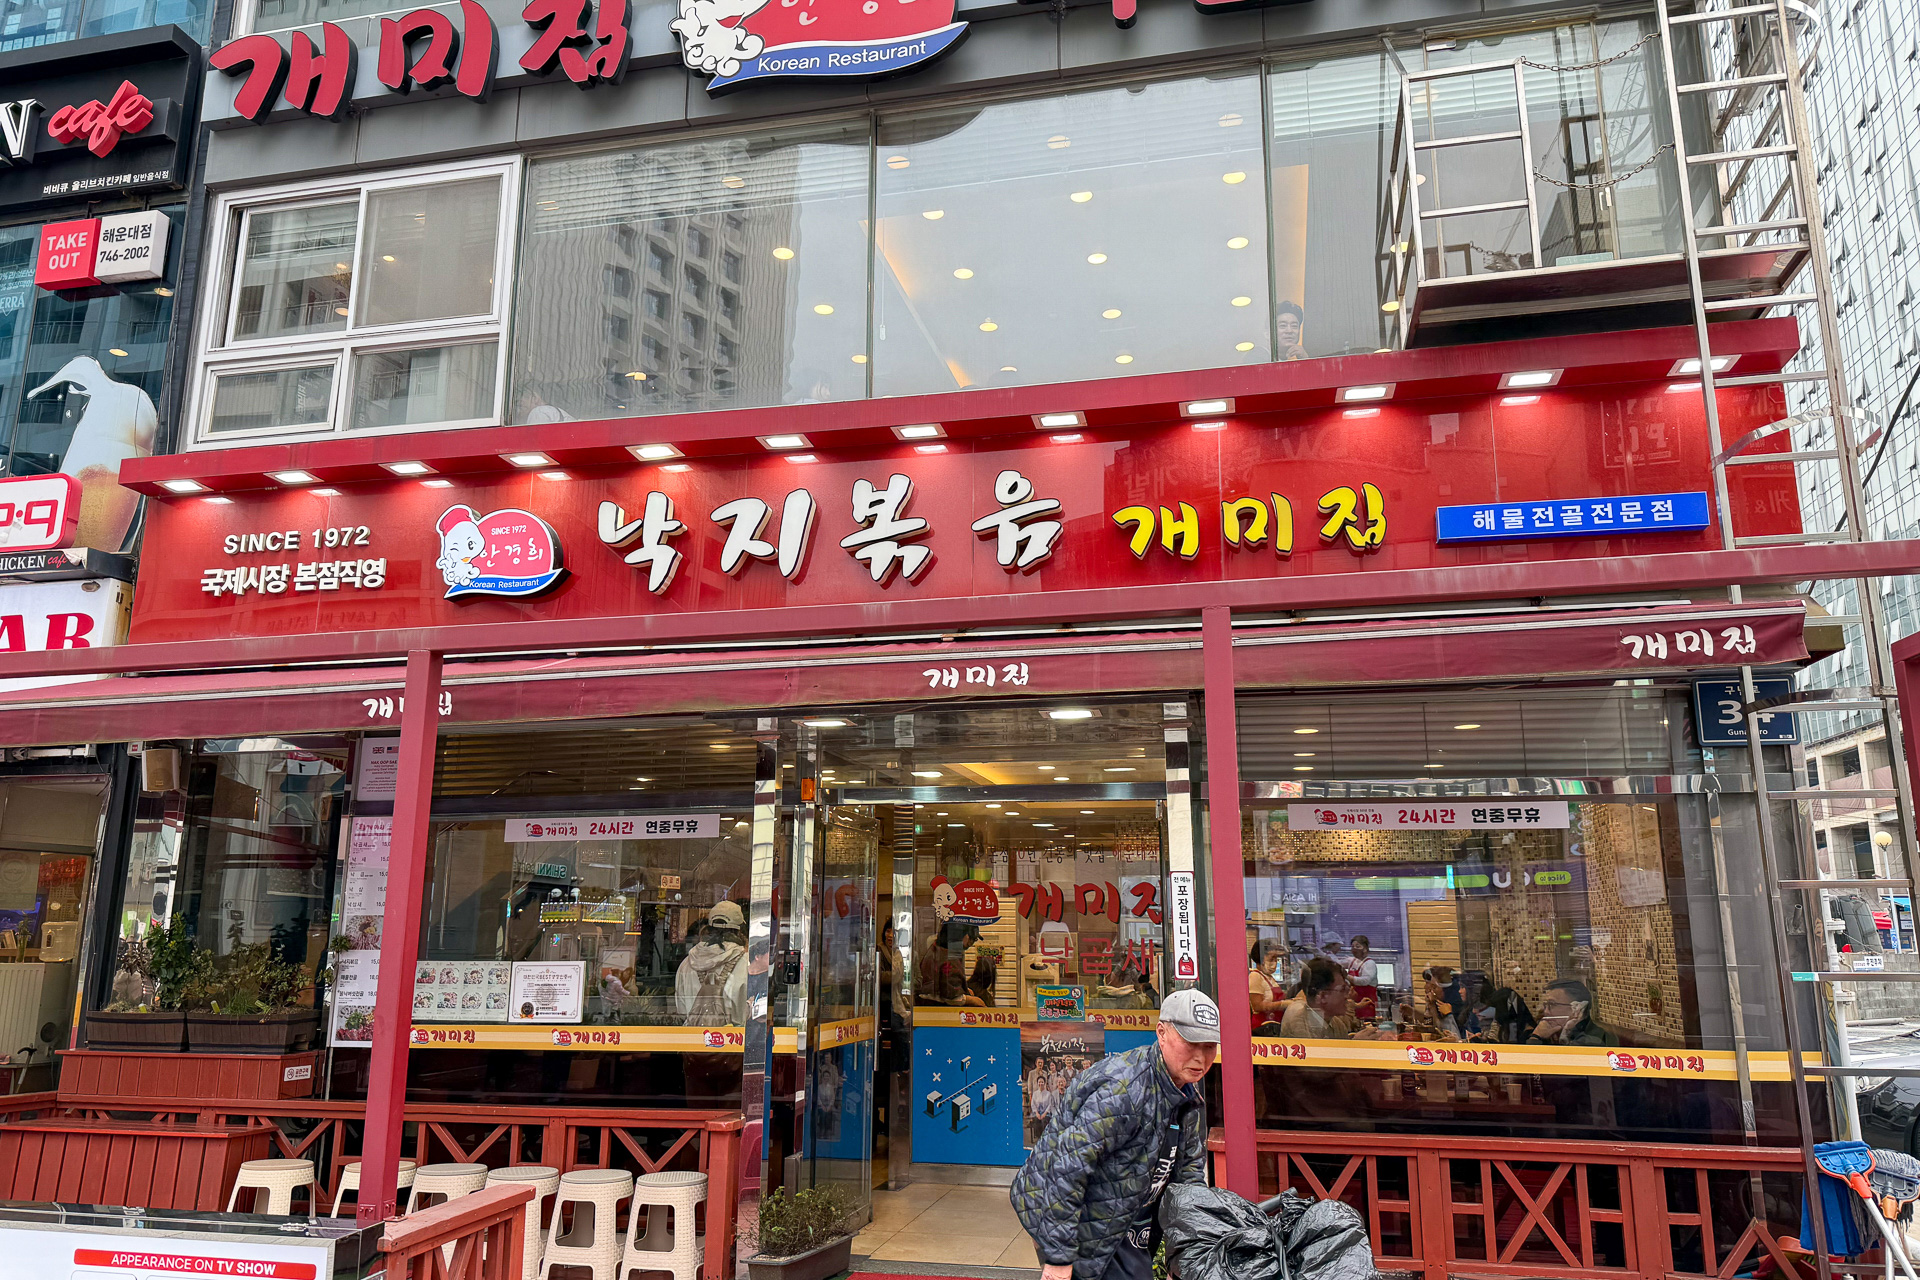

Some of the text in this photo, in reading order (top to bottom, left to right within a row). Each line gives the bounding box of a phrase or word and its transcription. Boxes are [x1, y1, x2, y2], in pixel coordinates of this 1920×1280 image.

[209, 0, 632, 121] 개미집
[758, 41, 926, 72] Korean Restaurant
[48, 80, 154, 158] cafe
[43, 170, 170, 194] 비비큐 올리브치킨카페 일반음식점
[47, 232, 88, 251] TAKE
[103, 223, 152, 243] 해운대점
[49, 253, 80, 270] OUT
[100, 246, 150, 262] 746-2002
[1112, 482, 1387, 561] 개미집
[1472, 498, 1675, 530] 해물전골전문점
[223, 526, 370, 554] SINCE 1972
[491, 525, 527, 535] SINCE 1972
[480, 537, 543, 567] 안경희
[201, 558, 387, 597] 국제시장 본점직영
[469, 579, 539, 588] Korean Restaurant
[1620, 624, 1756, 659] 개미집
[922, 662, 1029, 689] 개미집
[1340, 812, 1383, 825] 개미집
[1398, 808, 1456, 824] 24시간
[1471, 807, 1541, 823] 연중무휴
[545, 826, 577, 836] 개미집
[589, 821, 634, 835] 24시간
[645, 819, 698, 834] 연중무휴
[957, 896, 995, 910] 안경희
[1177, 886, 1192, 951] 포장됩니다
[1040, 937, 1155, 976] 낙곱새
[978, 1013, 1018, 1024] 개미집
[1107, 1014, 1150, 1027] 개미집
[430, 1030, 476, 1044] 개미집
[574, 1031, 621, 1045] 개미집
[1435, 1047, 1498, 1067] 개미집
[1638, 1053, 1705, 1073] 개미집
[111, 1253, 276, 1276] APPEARANCE ON TV SHOW
